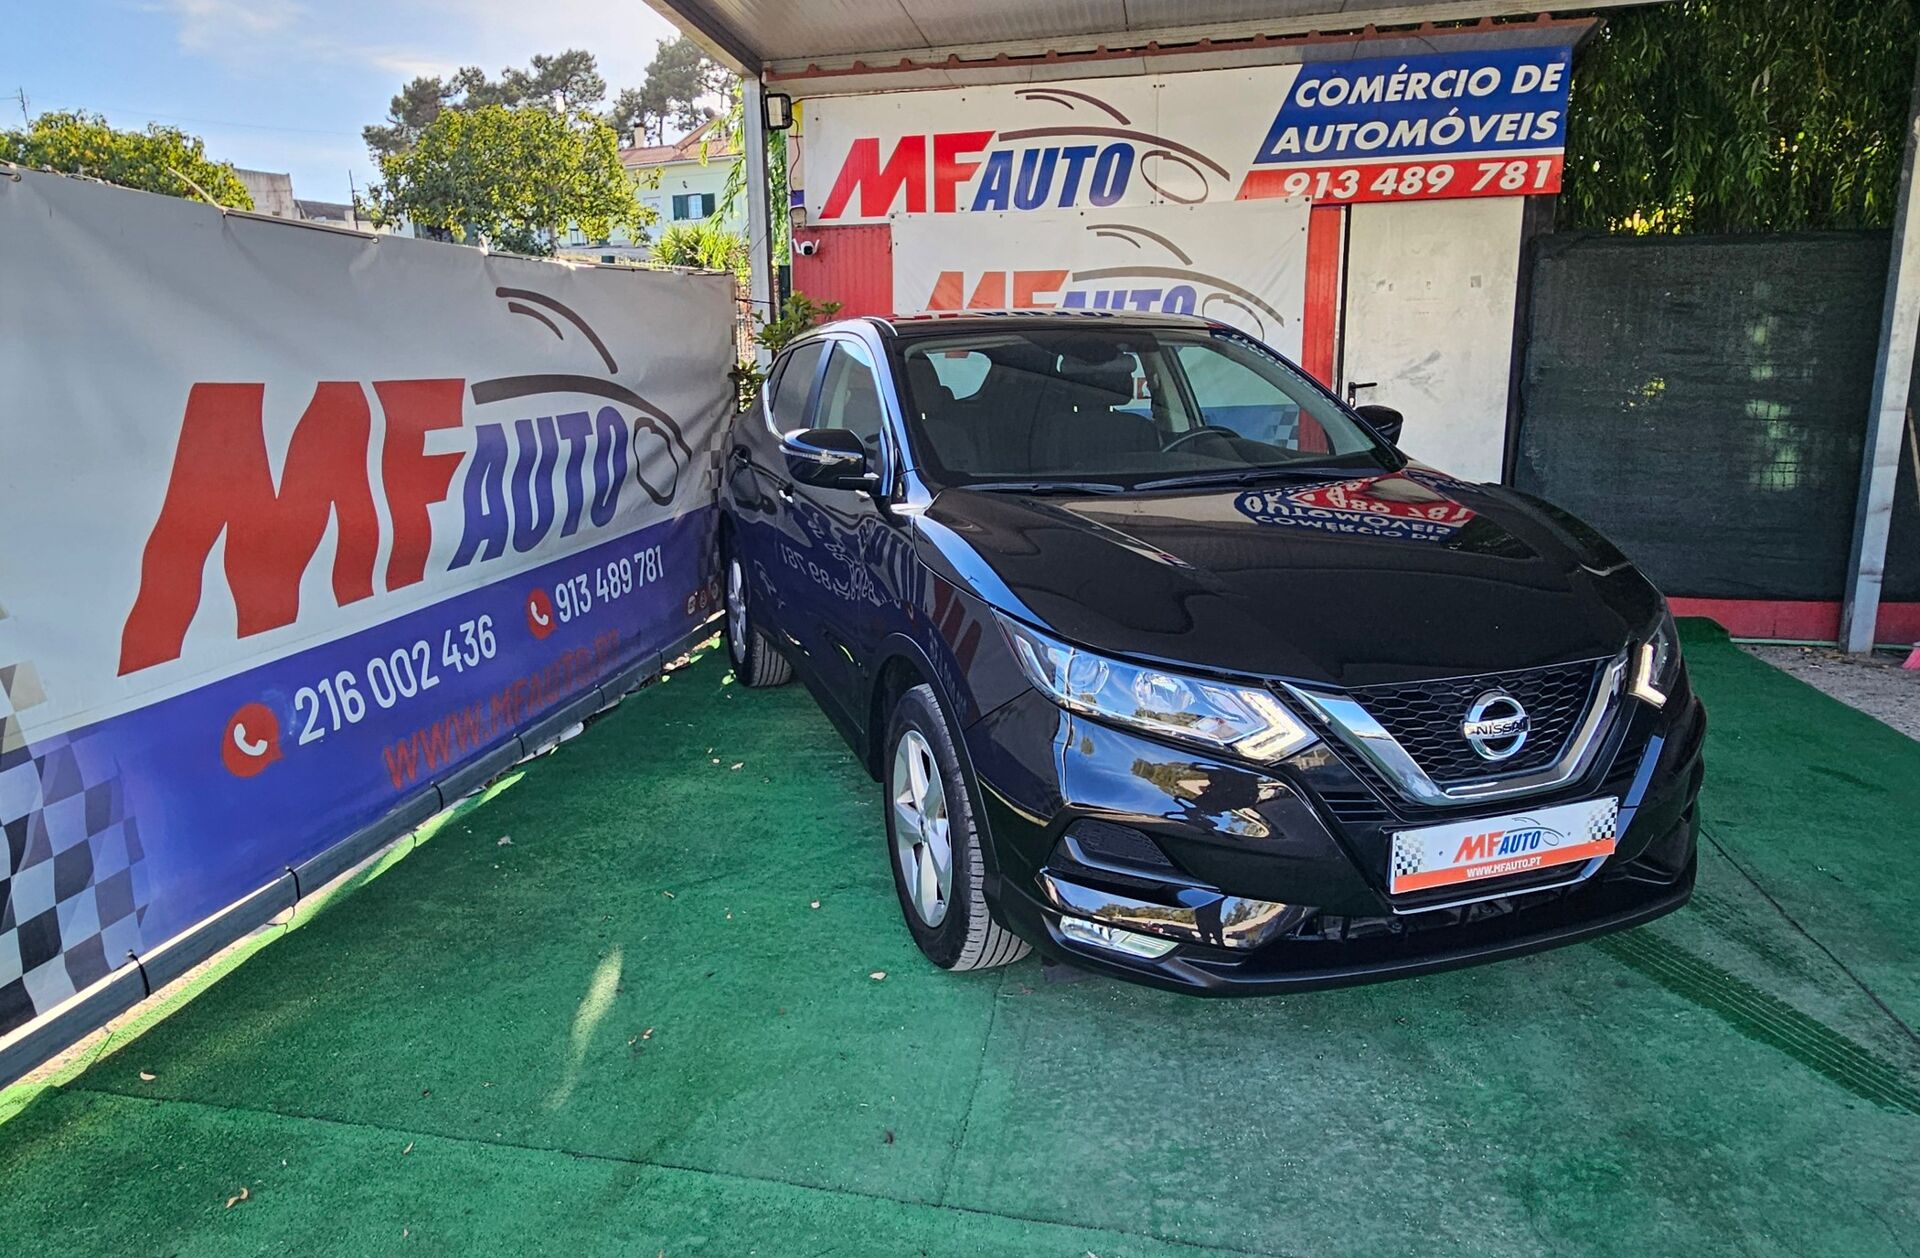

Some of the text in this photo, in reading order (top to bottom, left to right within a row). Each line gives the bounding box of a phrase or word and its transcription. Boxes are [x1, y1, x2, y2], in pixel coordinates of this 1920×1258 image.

[1296, 63, 1565, 108] COMÉRCIO DE
[1271, 107, 1560, 154] AUTOMÓVEIS
[1284, 160, 1551, 199] 913 489 781
[555, 545, 664, 623] 913 489 781
[294, 614, 497, 746] 216 002 436
[1476, 714, 1528, 736] NISSAN
[1467, 857, 1542, 878] WWW.MFAUTO.PT
